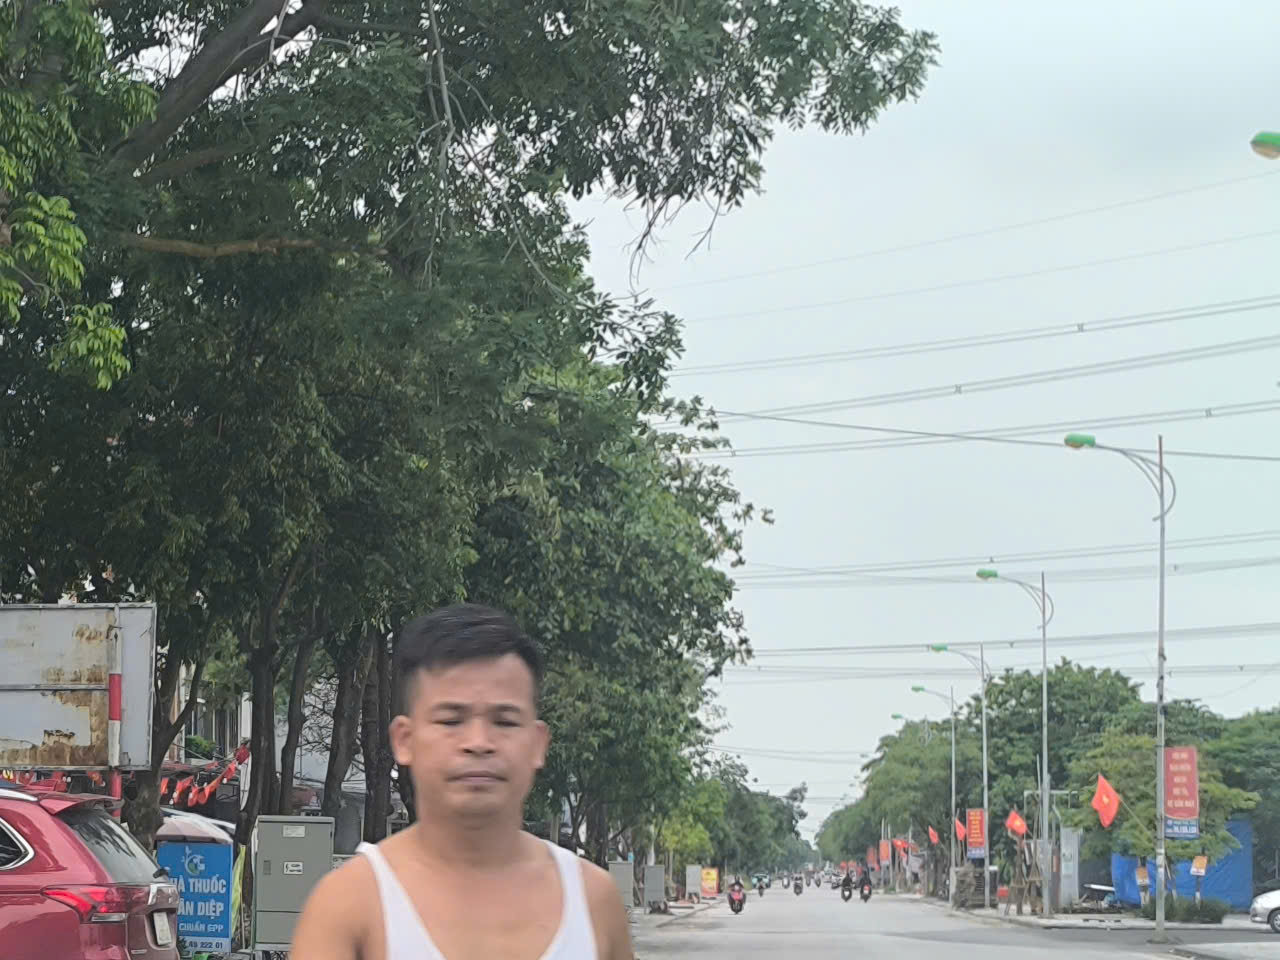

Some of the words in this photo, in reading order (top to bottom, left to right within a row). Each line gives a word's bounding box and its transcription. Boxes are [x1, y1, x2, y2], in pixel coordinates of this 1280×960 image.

[188, 874, 226, 893] THUỐC
[177, 896, 194, 916] ÂN
[198, 899, 224, 919] DIỆP
